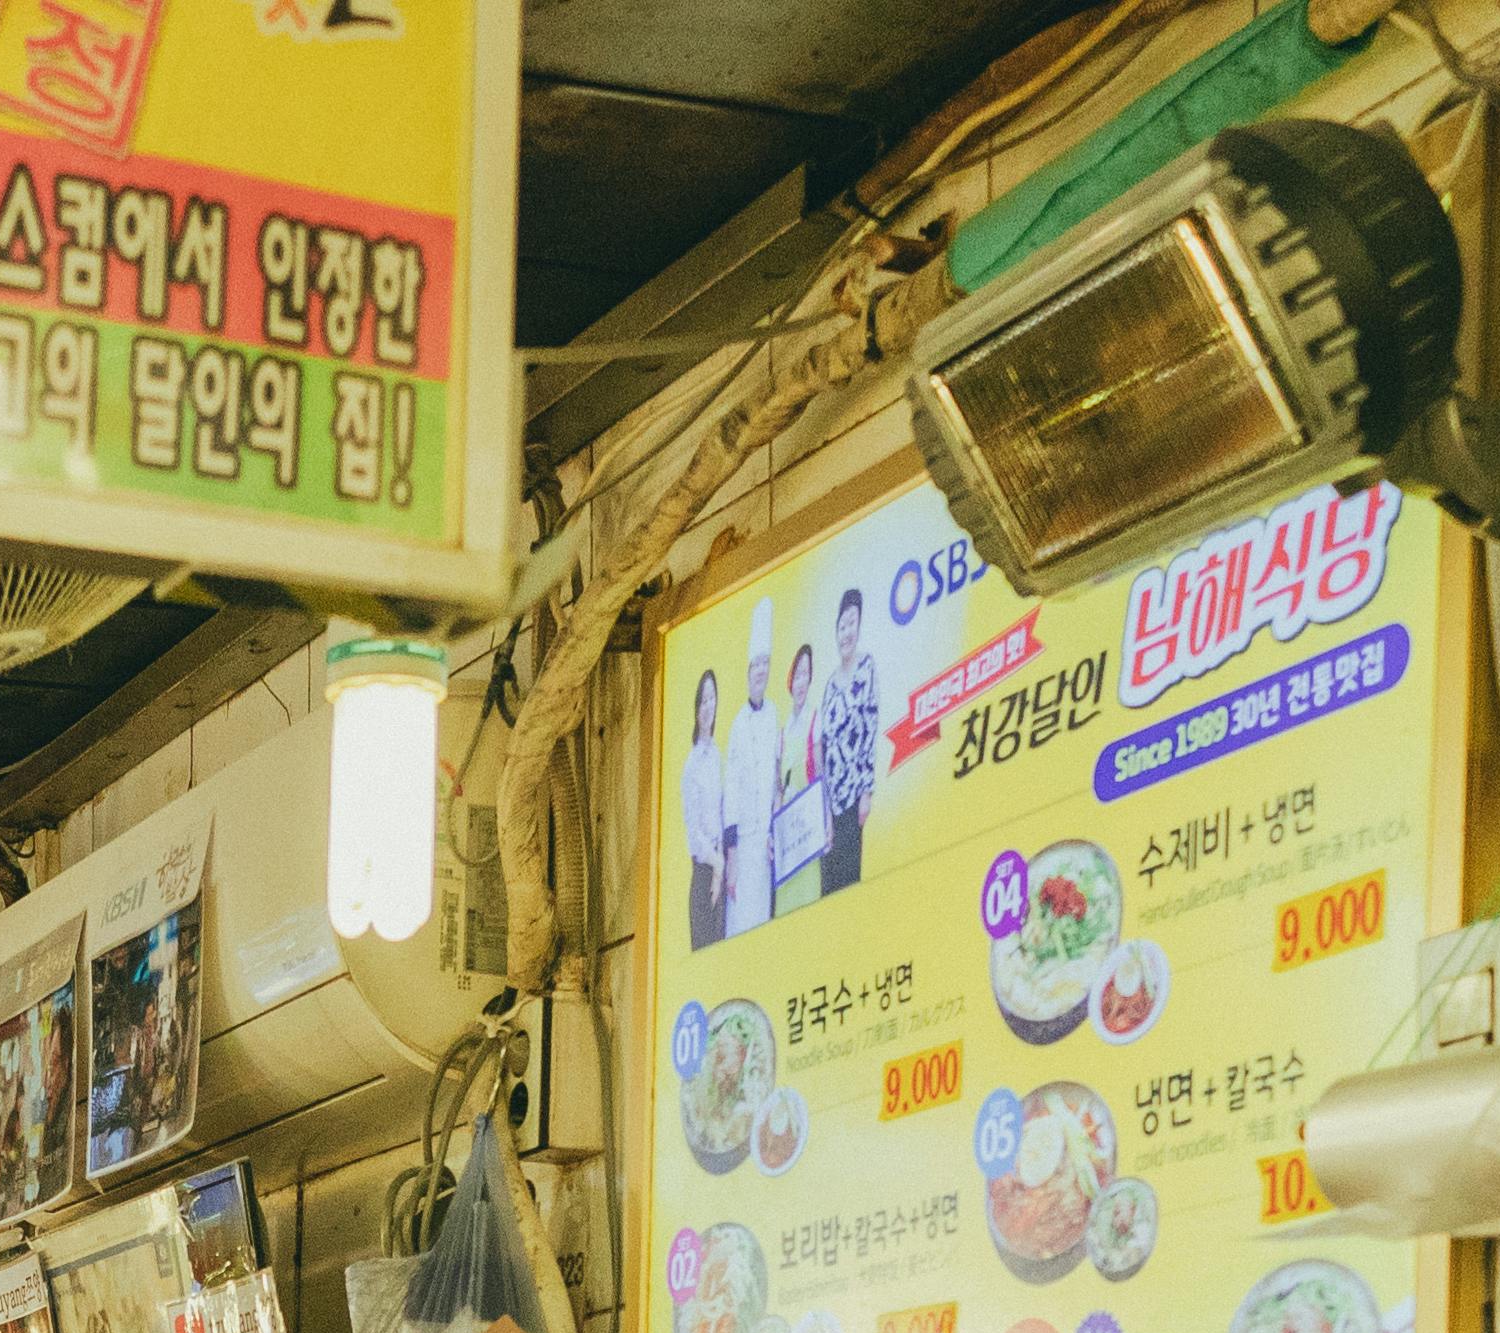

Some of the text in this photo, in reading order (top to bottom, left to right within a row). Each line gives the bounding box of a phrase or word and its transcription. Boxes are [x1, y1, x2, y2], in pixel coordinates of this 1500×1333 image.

[259, 211, 424, 371] 인정한
[131, 336, 302, 488] 달인의
[333, 371, 416, 508] 집!
[1130, 482, 1390, 690] 남해식당
[953, 650, 1110, 780] 최강달인
[1113, 637, 1387, 784] Since 1989 30년 전통맛집
[1137, 806, 1233, 889] 수제비
[1261, 783, 1317, 847] 냉면
[985, 874, 1025, 926] 04
[1279, 879, 1381, 964] 9.000
[676, 1025, 700, 1066] 01
[885, 1046, 960, 1114] 9.000
[1134, 1068, 1195, 1137] 냉면
[1226, 1047, 1306, 1114] 칼국수
[980, 1112, 1015, 1164] 05
[1262, 1155, 1318, 1218] 10.
[669, 1249, 697, 1292] 02
[779, 1190, 960, 1271] 보리밥+칼국수+냉면
